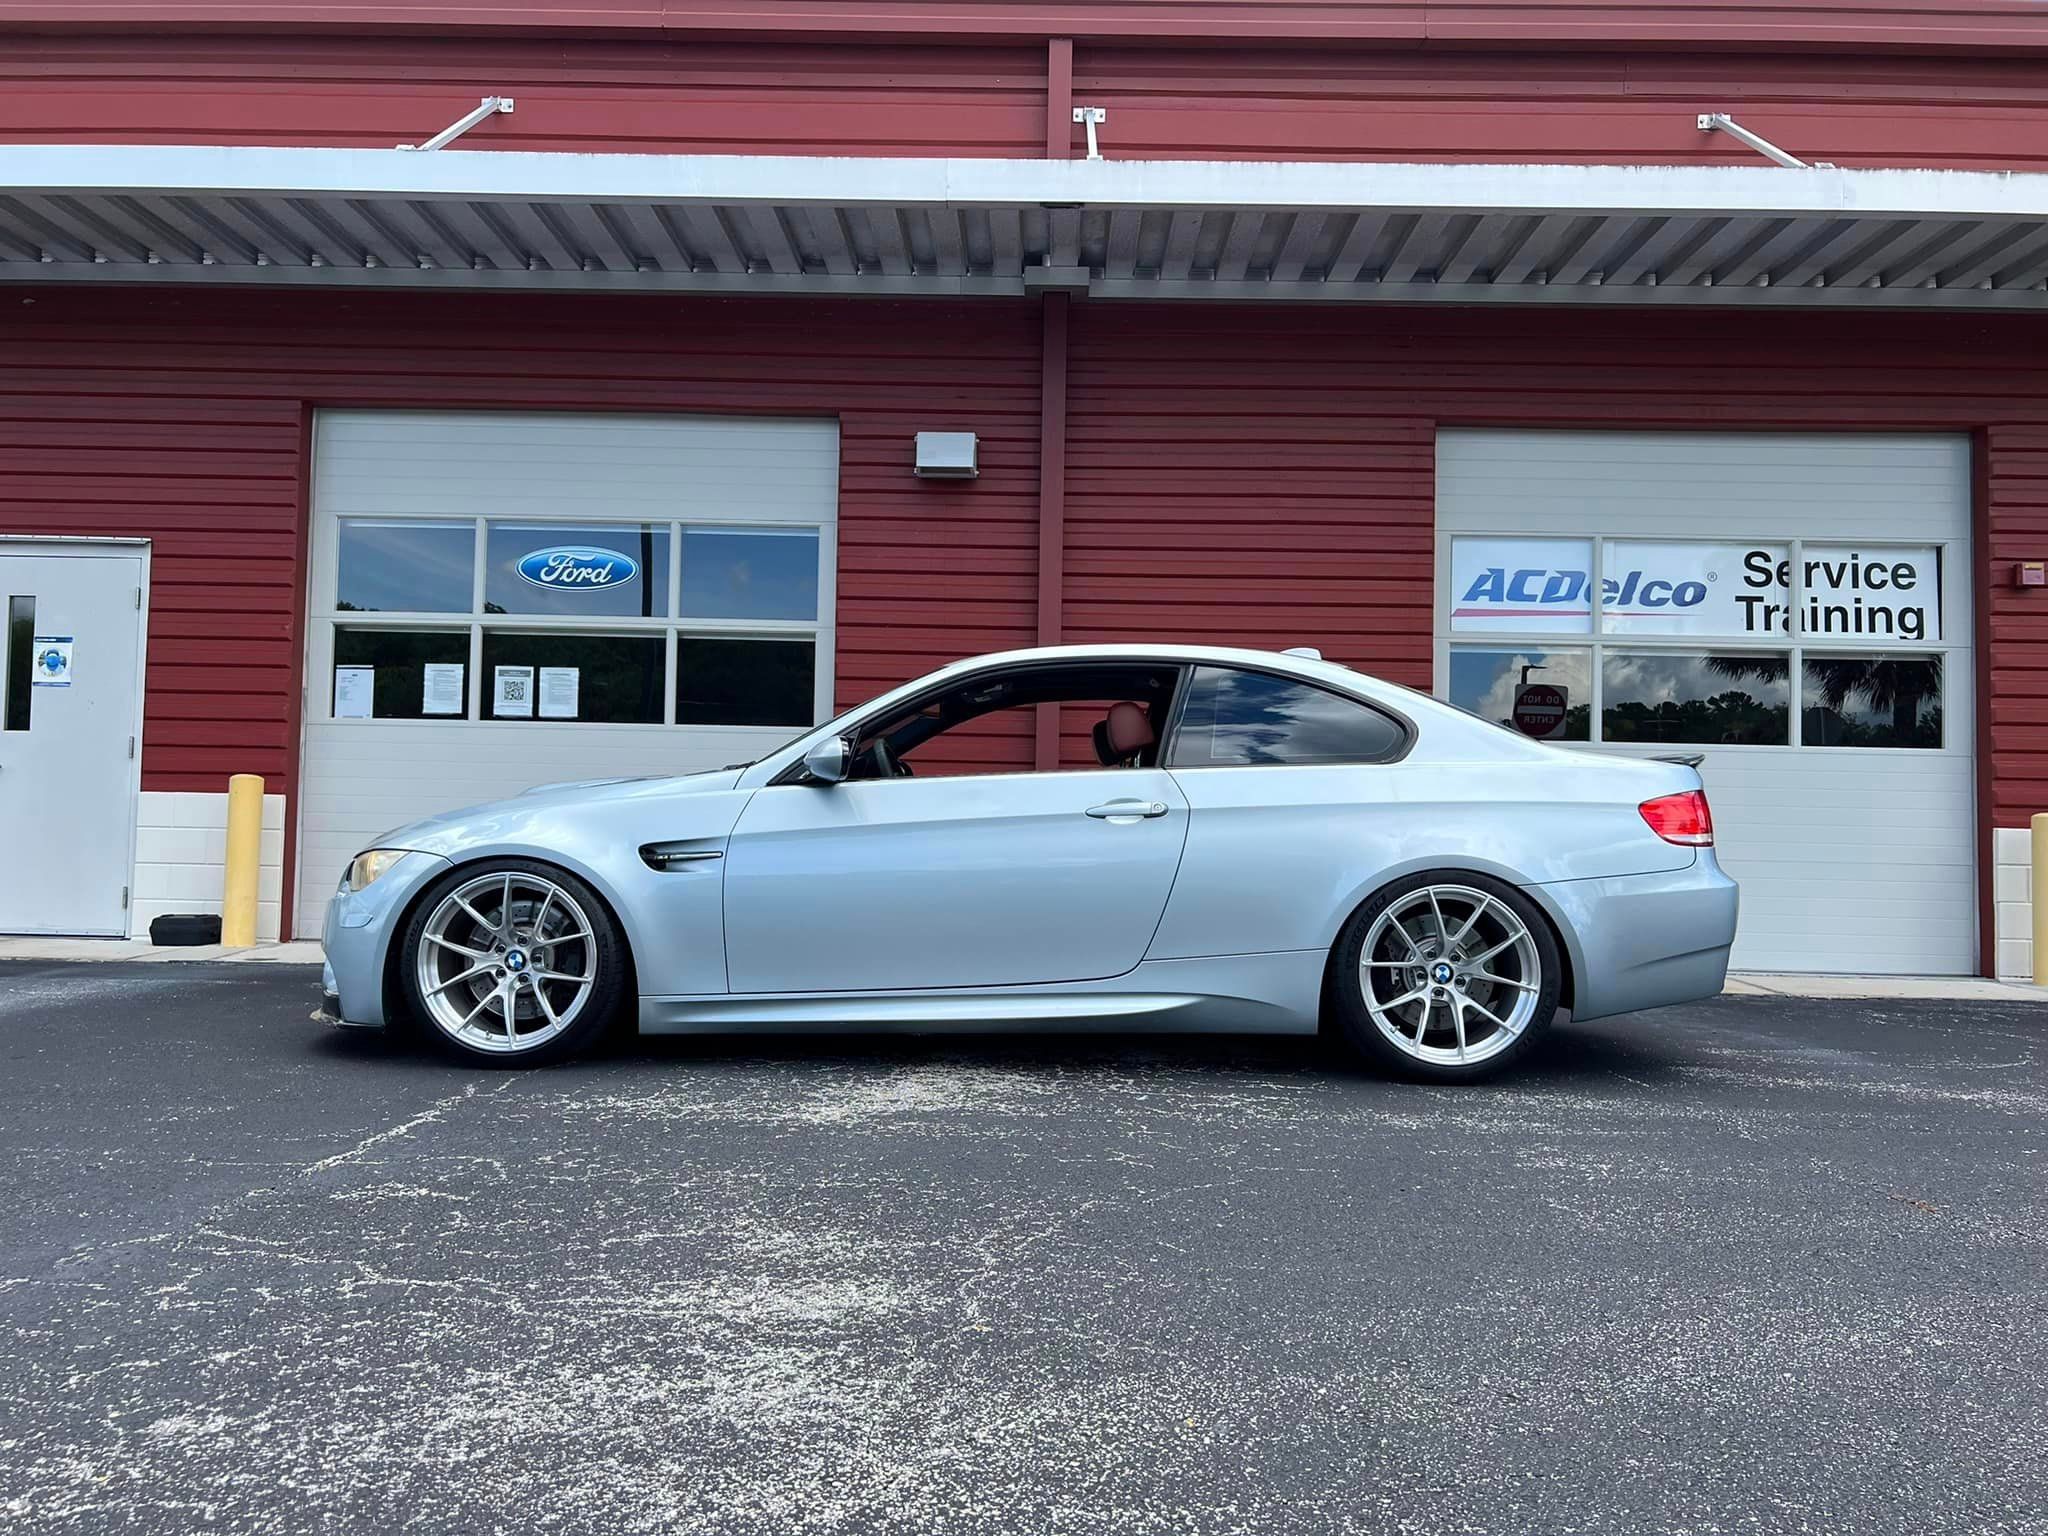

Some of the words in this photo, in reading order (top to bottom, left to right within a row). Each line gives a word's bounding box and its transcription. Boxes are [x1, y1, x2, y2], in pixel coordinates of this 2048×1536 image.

[540, 552, 614, 583] Ford
[1743, 550, 1916, 590] Service
[1462, 568, 1708, 607] ACDelco
